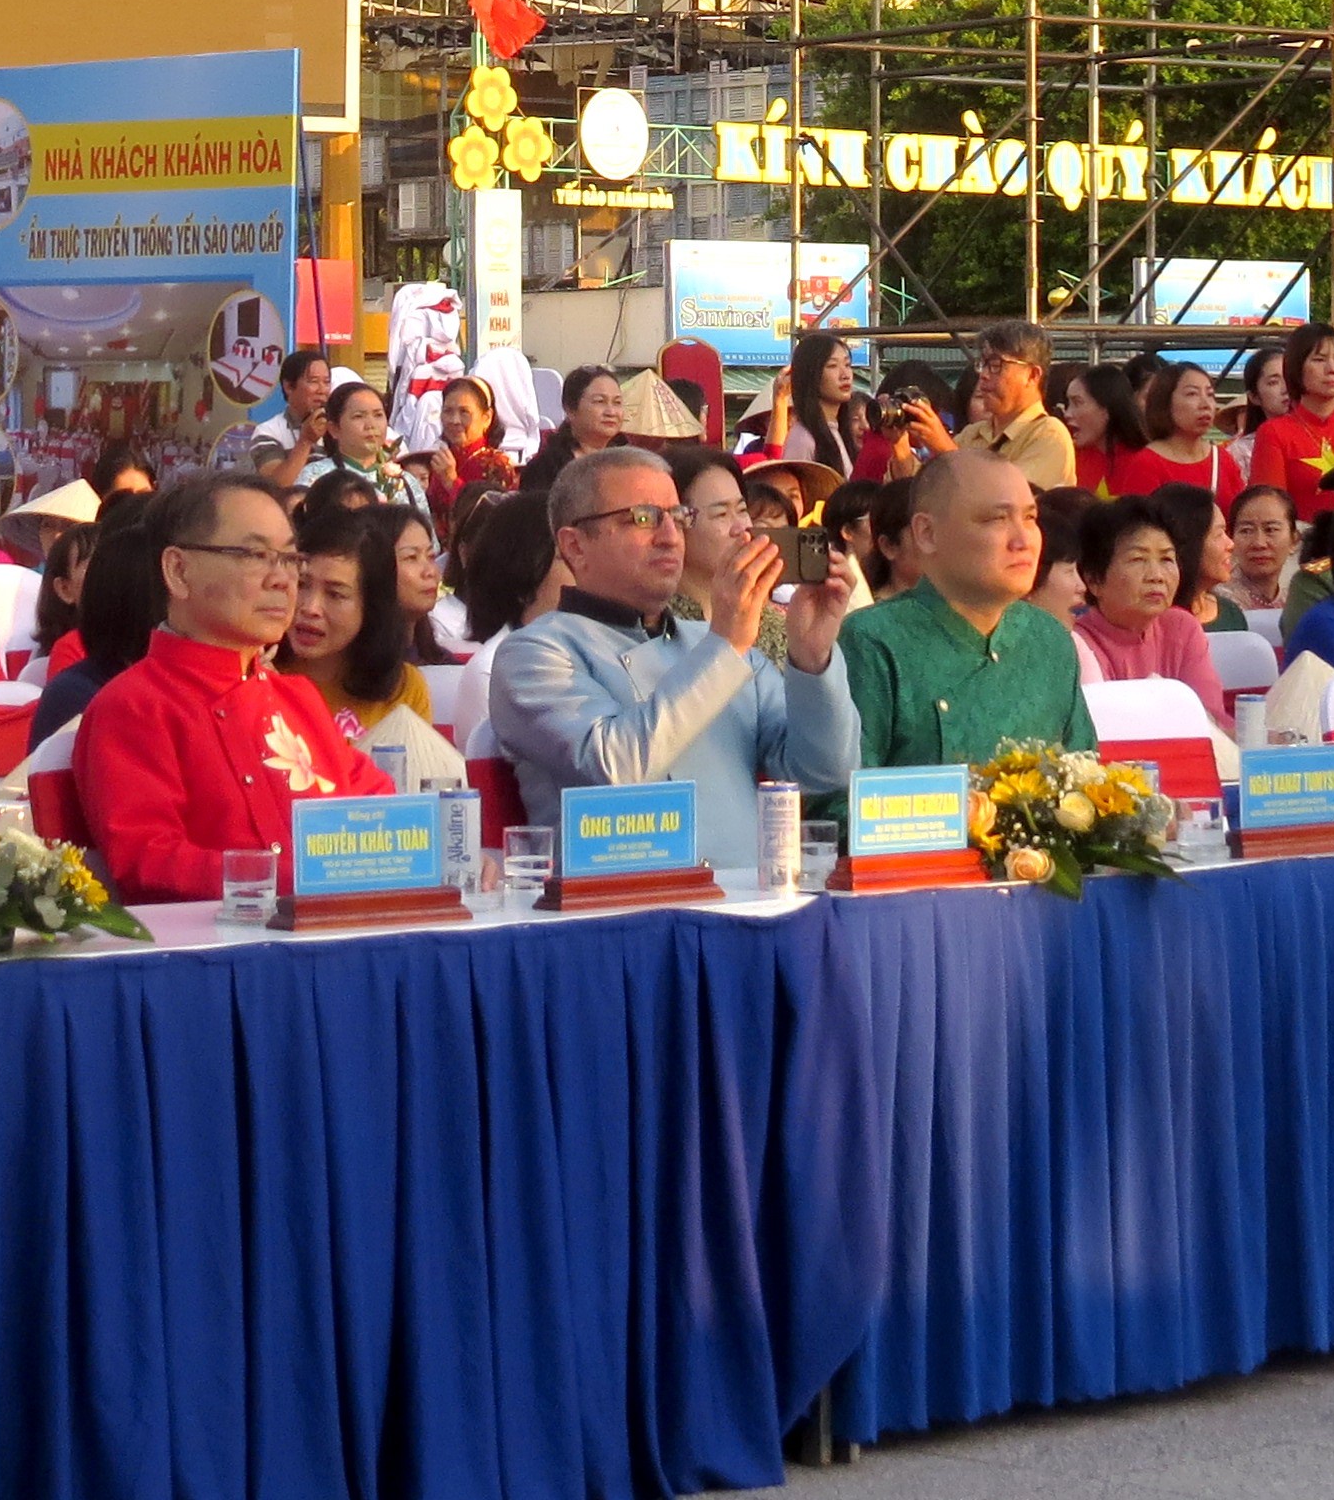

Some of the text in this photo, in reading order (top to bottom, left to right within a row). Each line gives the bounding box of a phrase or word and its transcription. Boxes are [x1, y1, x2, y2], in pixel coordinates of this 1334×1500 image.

[45, 129, 282, 181] NHÀ KHÁCH KHÁNH HÒA
[715, 97, 868, 187] KÍNH
[885, 109, 1029, 197] CHÀO
[1047, 119, 1149, 211] QUÝ
[83, 212, 130, 258] TRUYỀN
[133, 212, 173, 257] THỐNG
[176, 212, 201, 255] YẾN
[204, 215, 228, 255] SÀO
[231, 222, 255, 254] CAO
[259, 209, 284, 252] CẤP
[490, 290, 509, 306] NHÀ
[680, 297, 771, 329] Sanvinest
[489, 317, 511, 331] KHAI
[396, 824, 429, 851] TOÀN
[580, 810, 681, 839] ÔNG CHAK AU
